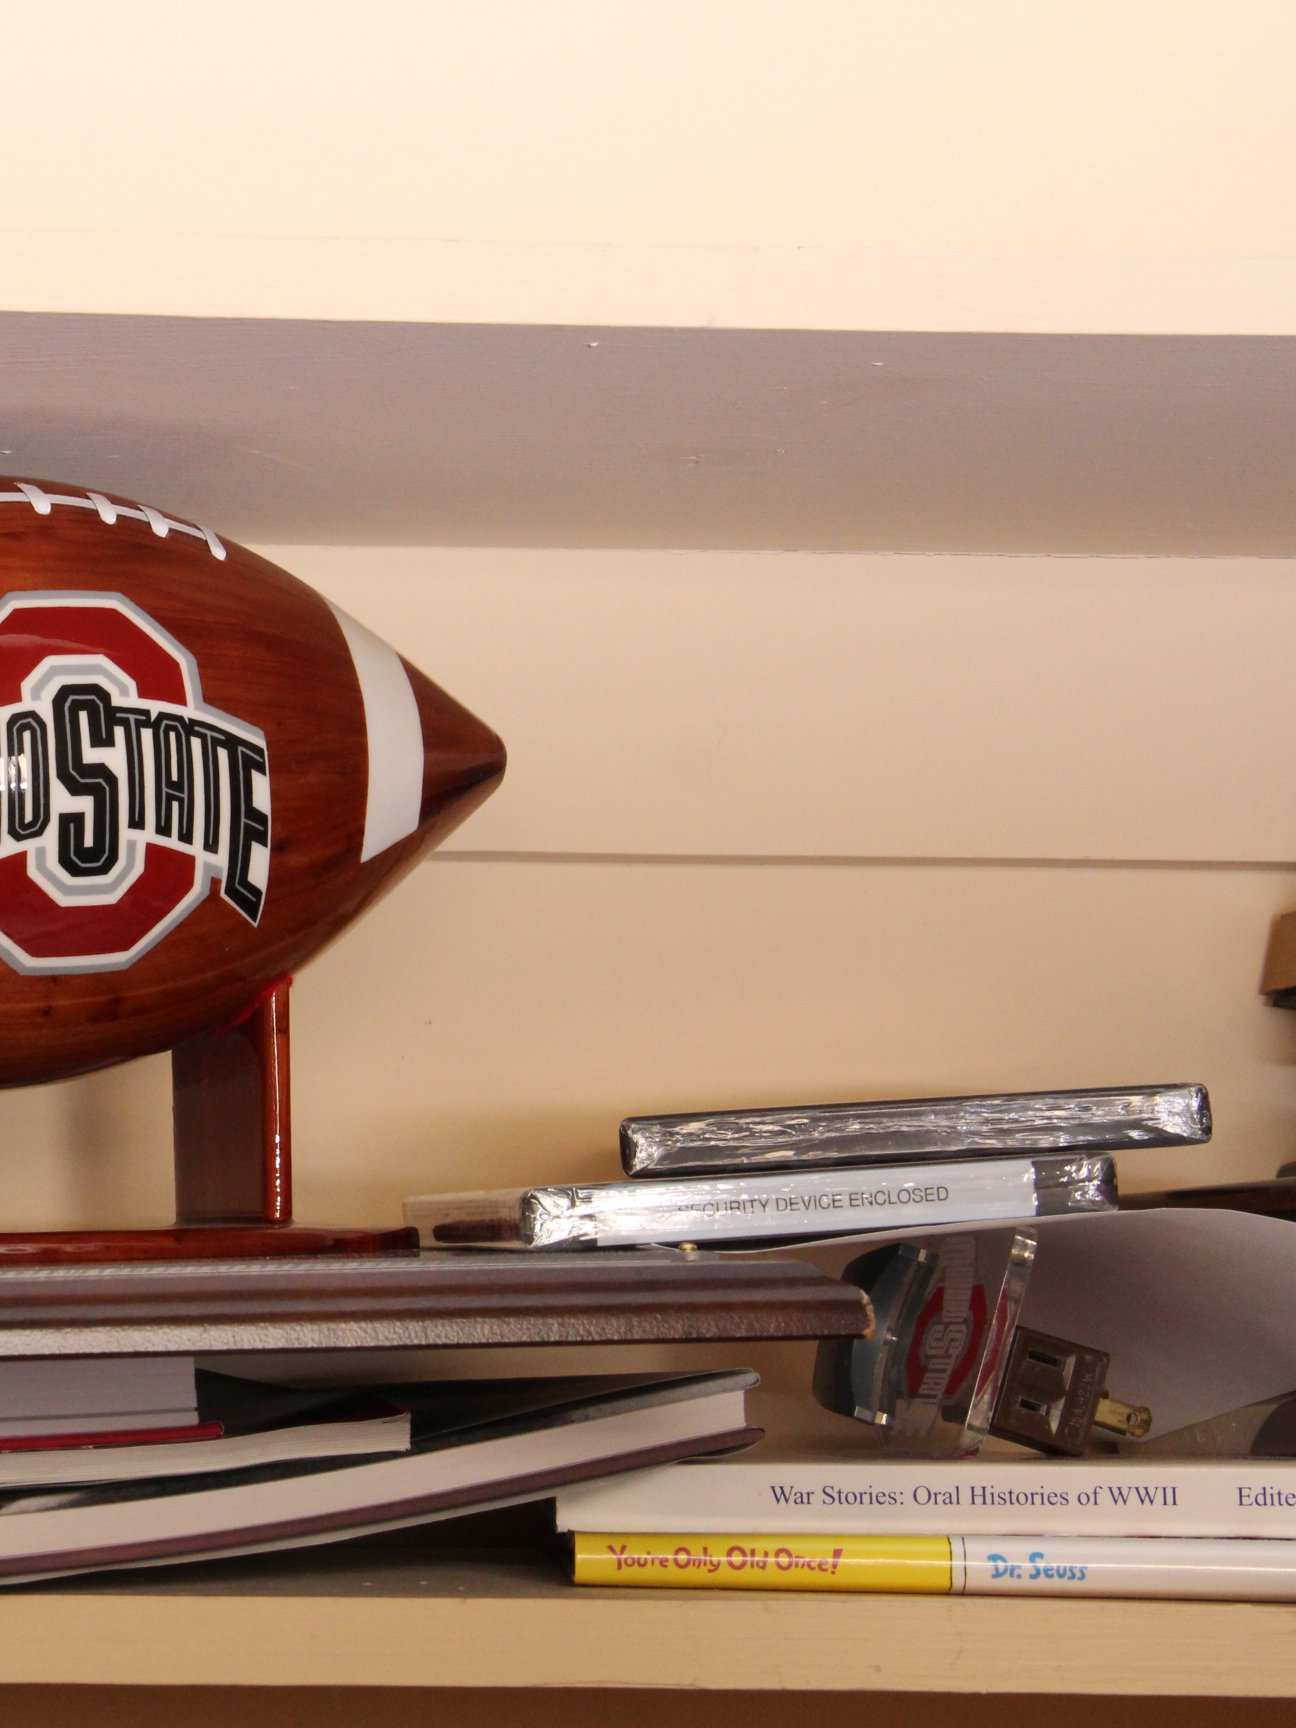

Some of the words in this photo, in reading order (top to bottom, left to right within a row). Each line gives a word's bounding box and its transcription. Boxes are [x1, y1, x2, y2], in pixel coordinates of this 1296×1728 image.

[51, 683, 270, 928] STATE
[678, 1198, 770, 1218] SECURITY
[776, 1193, 844, 1213] DEVICE
[849, 1185, 950, 1208] ENCLOSED
[769, 1485, 815, 1506] War
[821, 1484, 904, 1506] Stories:
[912, 1485, 961, 1506] Oral
[969, 1484, 1070, 1507] Histories
[1076, 1485, 1103, 1506] of
[1107, 1485, 1179, 1507] WWII
[606, 1543, 669, 1571] You're
[672, 1546, 721, 1573] Only
[725, 1545, 769, 1571] Old
[773, 1547, 844, 1575] Once!
[987, 1553, 1023, 1579] Dr.
[1028, 1551, 1088, 1581] Seuss
